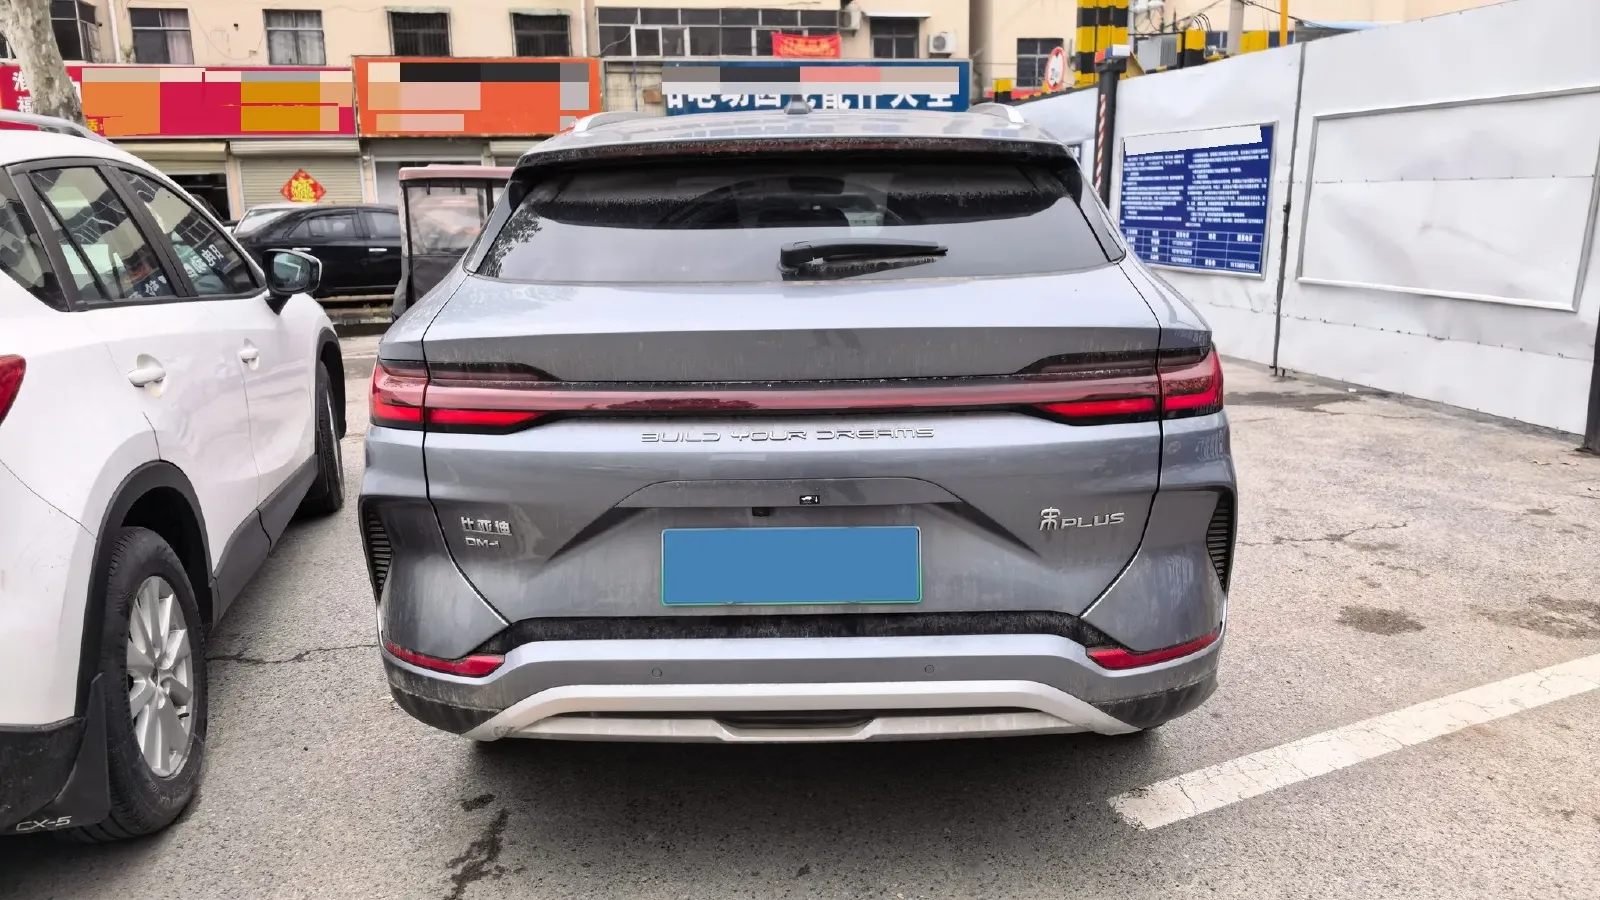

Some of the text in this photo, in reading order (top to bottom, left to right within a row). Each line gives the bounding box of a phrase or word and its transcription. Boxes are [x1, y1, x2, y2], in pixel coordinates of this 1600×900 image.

[641, 427, 935, 442] BUILD YOUR DREAMS
[460, 516, 511, 534] 比亚迪
[15, 815, 73, 831] CX-5
